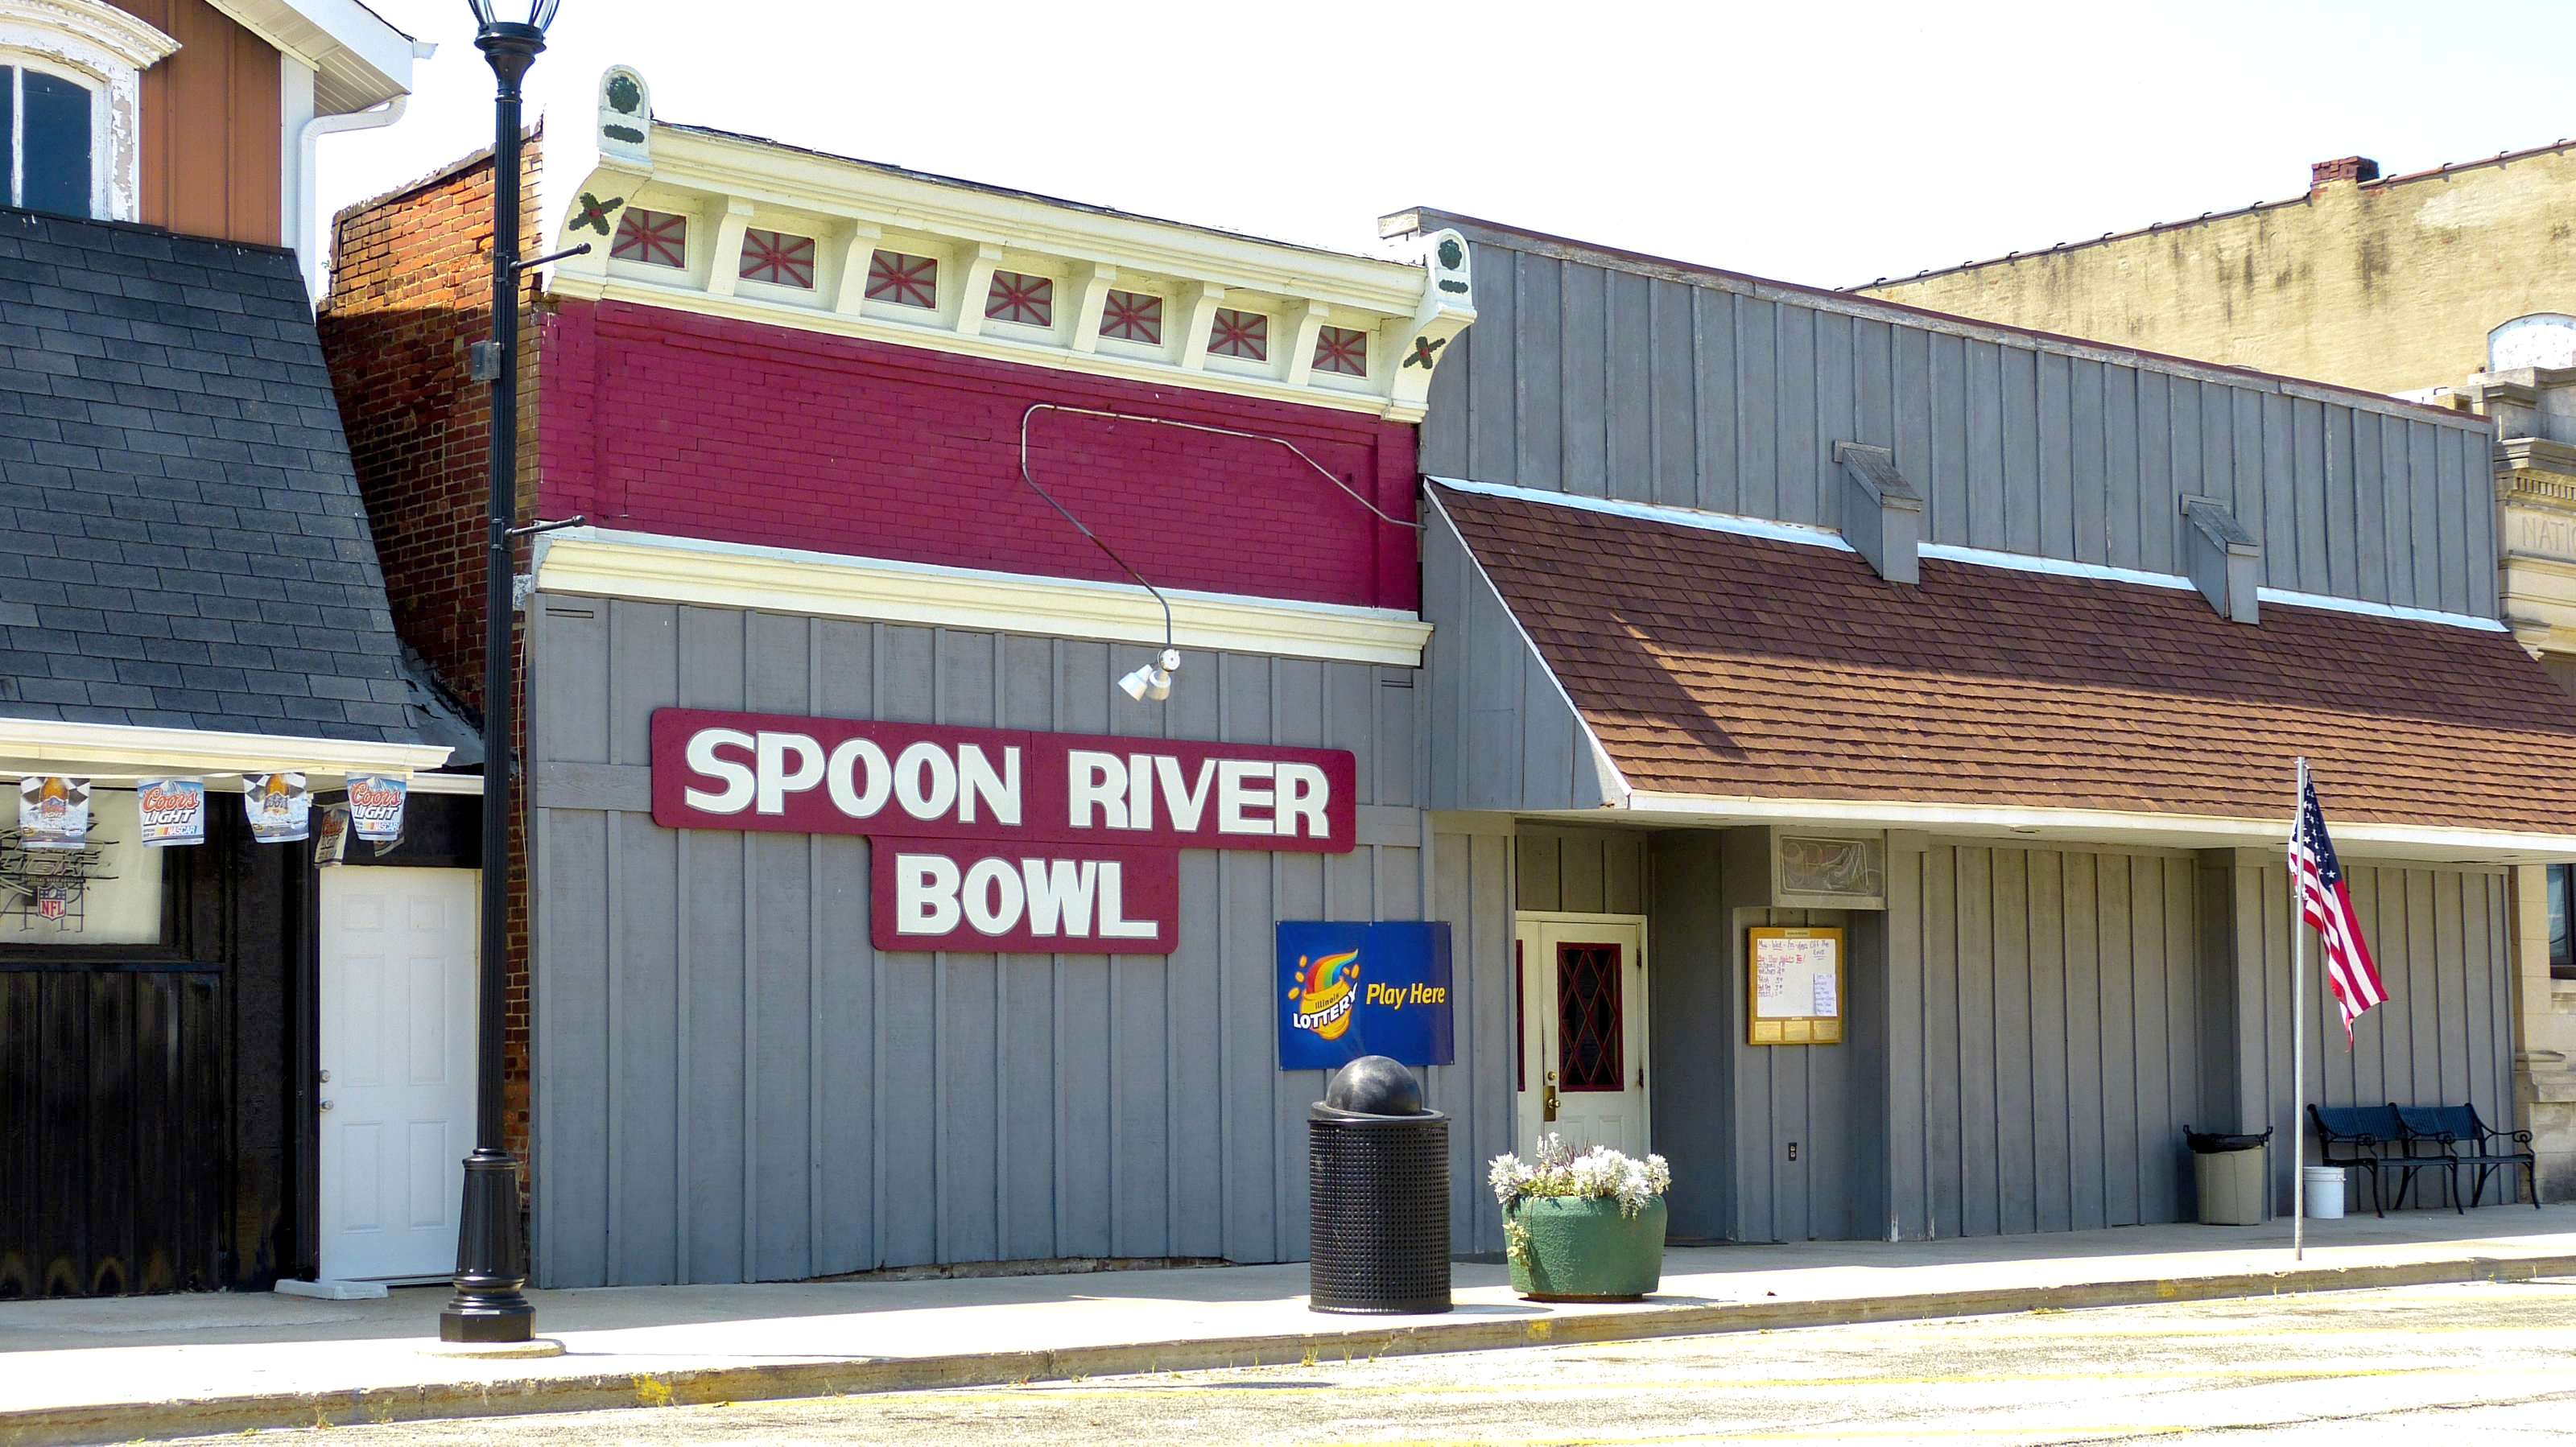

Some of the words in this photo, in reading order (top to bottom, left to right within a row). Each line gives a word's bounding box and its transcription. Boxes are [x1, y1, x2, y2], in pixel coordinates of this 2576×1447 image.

[350, 781, 402, 807] Coors
[683, 727, 1022, 827] SPOON
[1067, 749, 1331, 839] RIVER
[142, 786, 199, 813] Coors
[143, 810, 196, 826] LIGHT
[354, 806, 398, 820] LIGHT
[167, 826, 198, 835] NASCAR
[373, 822, 399, 831] NASCAR
[895, 853, 1160, 940] BOWL
[41, 900, 64, 917] NFL
[1293, 982, 1358, 1029] LOTTERY
[1315, 992, 1340, 1010] Illinois
[1366, 983, 1408, 1010] Play
[1410, 983, 1446, 1004] Here
